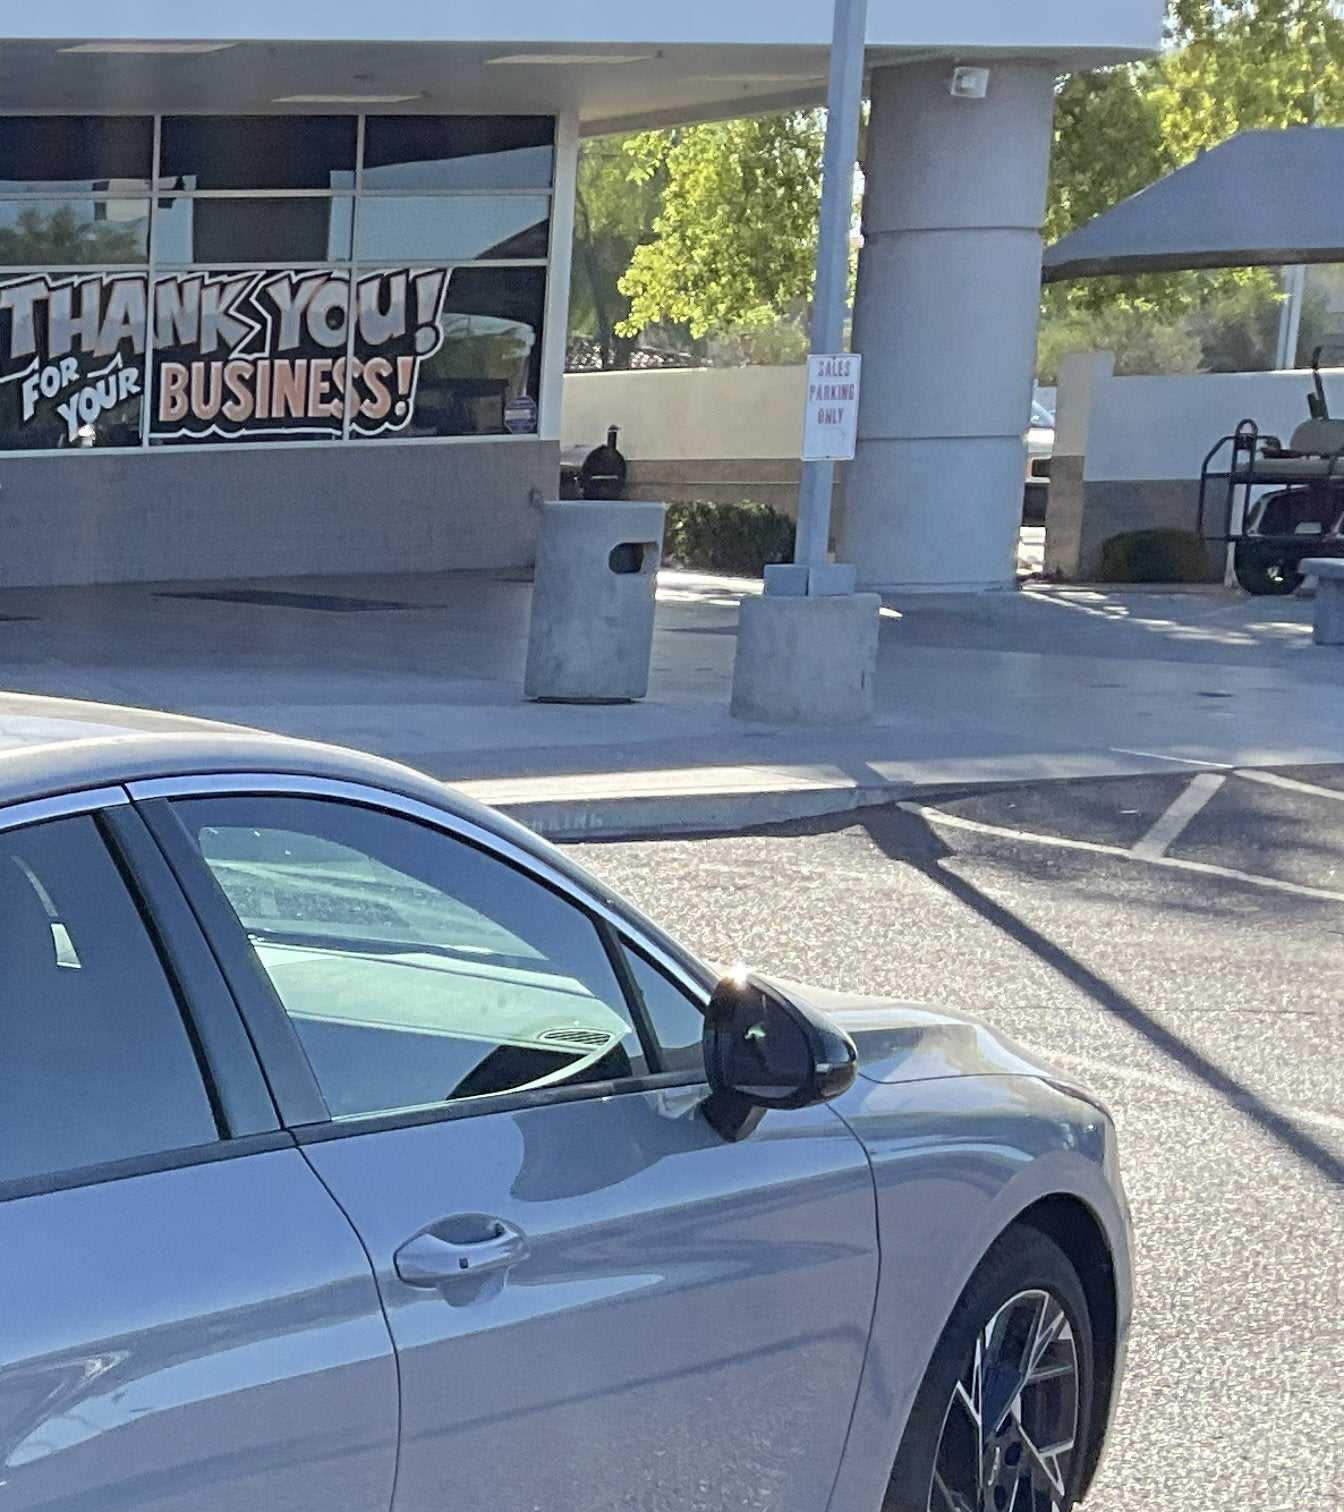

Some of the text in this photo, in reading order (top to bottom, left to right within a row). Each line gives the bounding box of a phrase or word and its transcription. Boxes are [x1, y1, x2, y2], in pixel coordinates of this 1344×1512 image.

[265, 271, 445, 355] YOU!
[22, 356, 80, 422] FOR
[158, 354, 414, 423] BUSINESS!
[808, 383, 856, 402] PARKING
[817, 360, 851, 377] SALES
[56, 366, 141, 443] YOUR
[817, 407, 844, 425] ONLY
